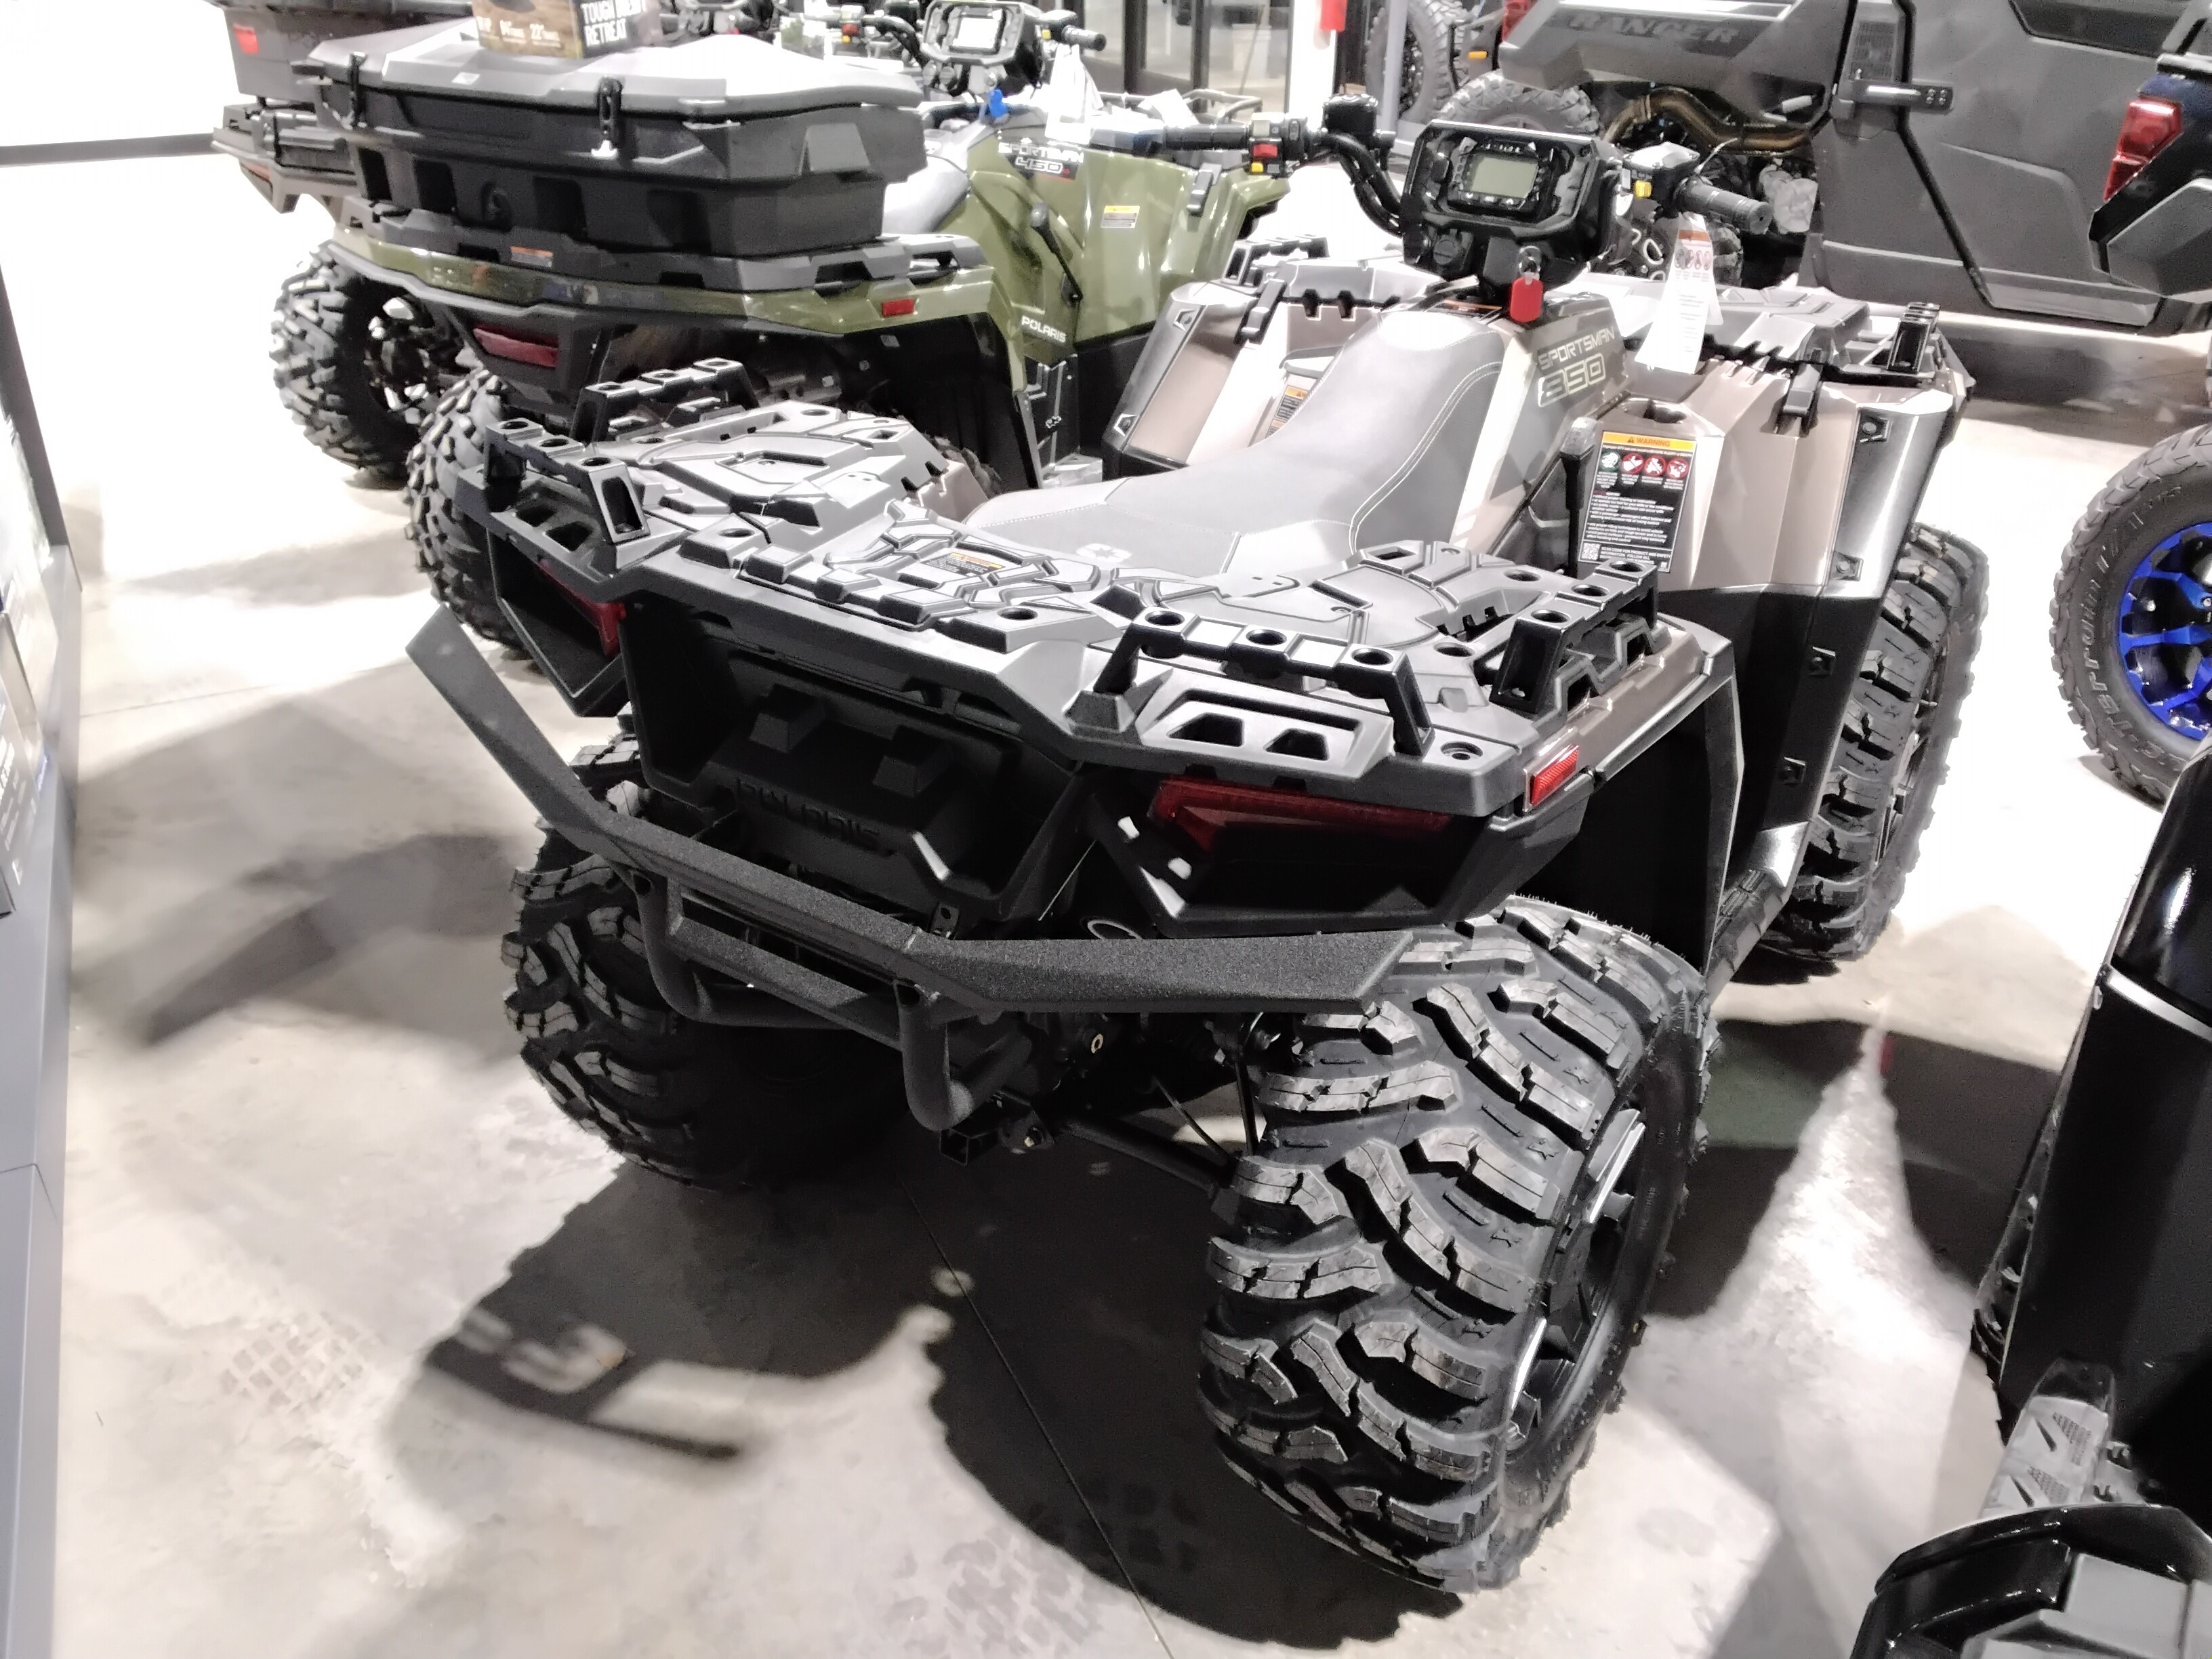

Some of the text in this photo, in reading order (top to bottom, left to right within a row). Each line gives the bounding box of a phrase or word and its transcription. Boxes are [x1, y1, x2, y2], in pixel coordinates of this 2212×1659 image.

[584, 18, 627, 47] RETREAT
[1568, 12, 1740, 43] RANGER
[998, 142, 1084, 163] SPORTSMAN
[1015, 157, 1063, 174] 450
[1021, 315, 1067, 343] POLARIS
[1538, 326, 1616, 371] SPORTSMAN
[1637, 437, 1671, 447] WARNING
